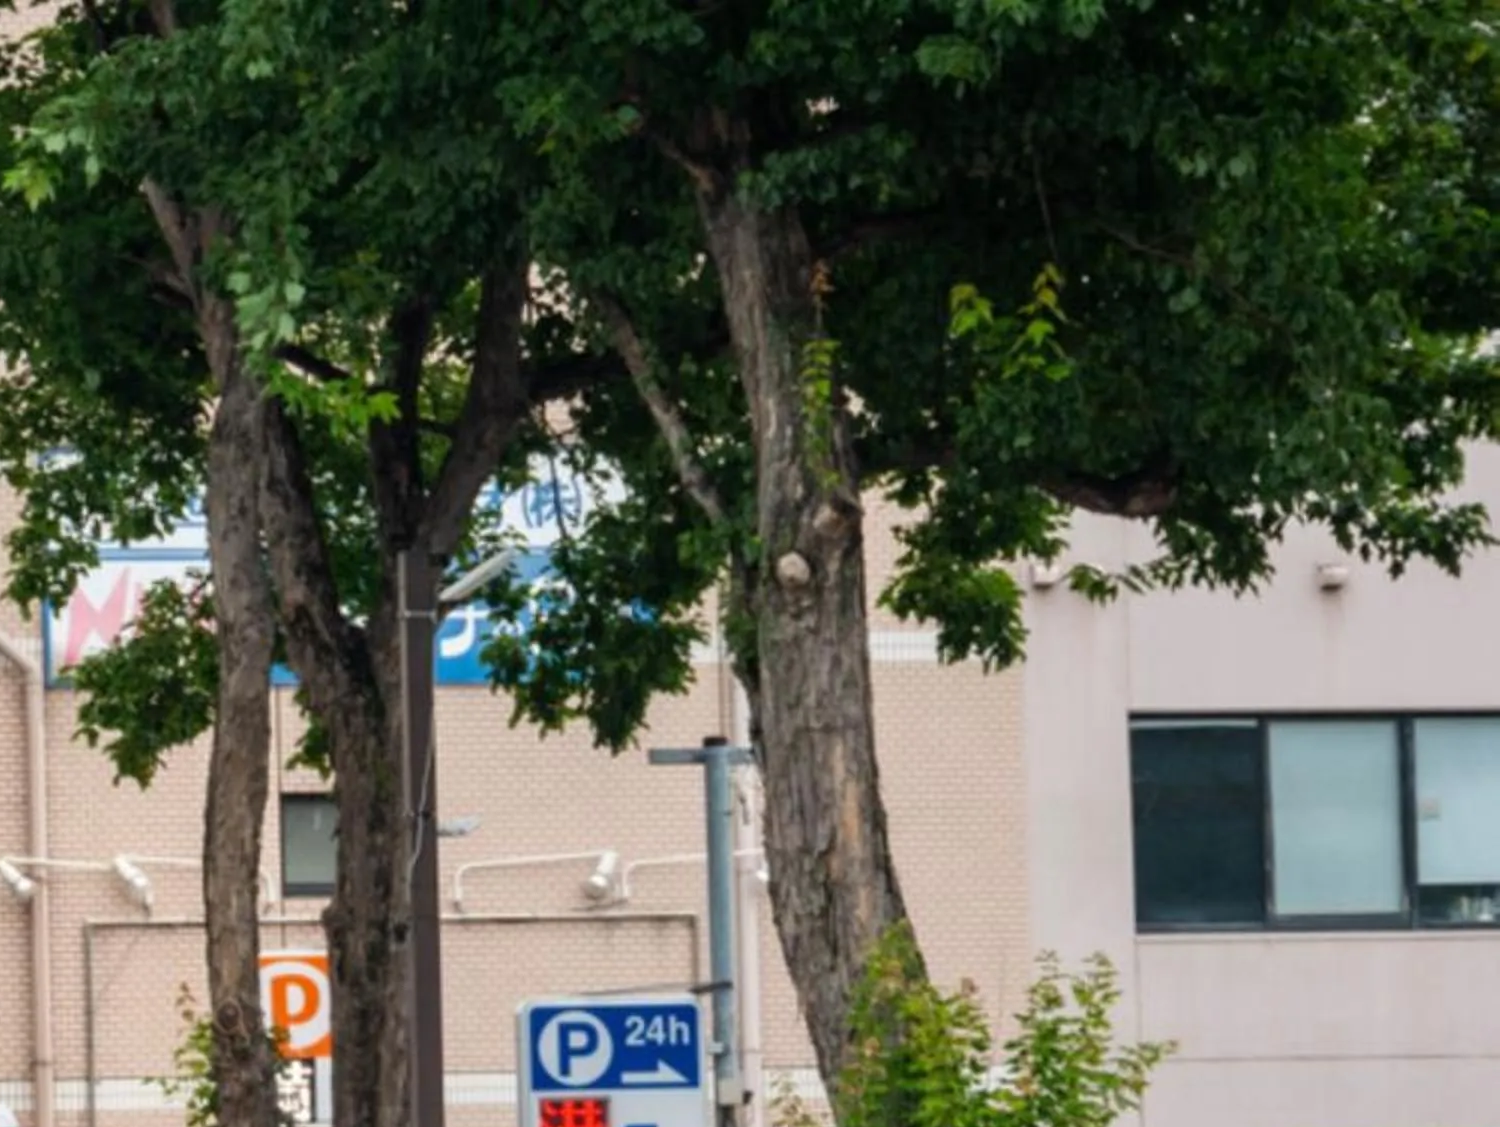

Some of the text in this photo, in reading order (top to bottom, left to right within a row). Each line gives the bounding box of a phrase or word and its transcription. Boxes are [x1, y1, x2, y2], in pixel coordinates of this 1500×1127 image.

[271, 973, 320, 1040] P
[558, 1014, 690, 1077] P 24h
